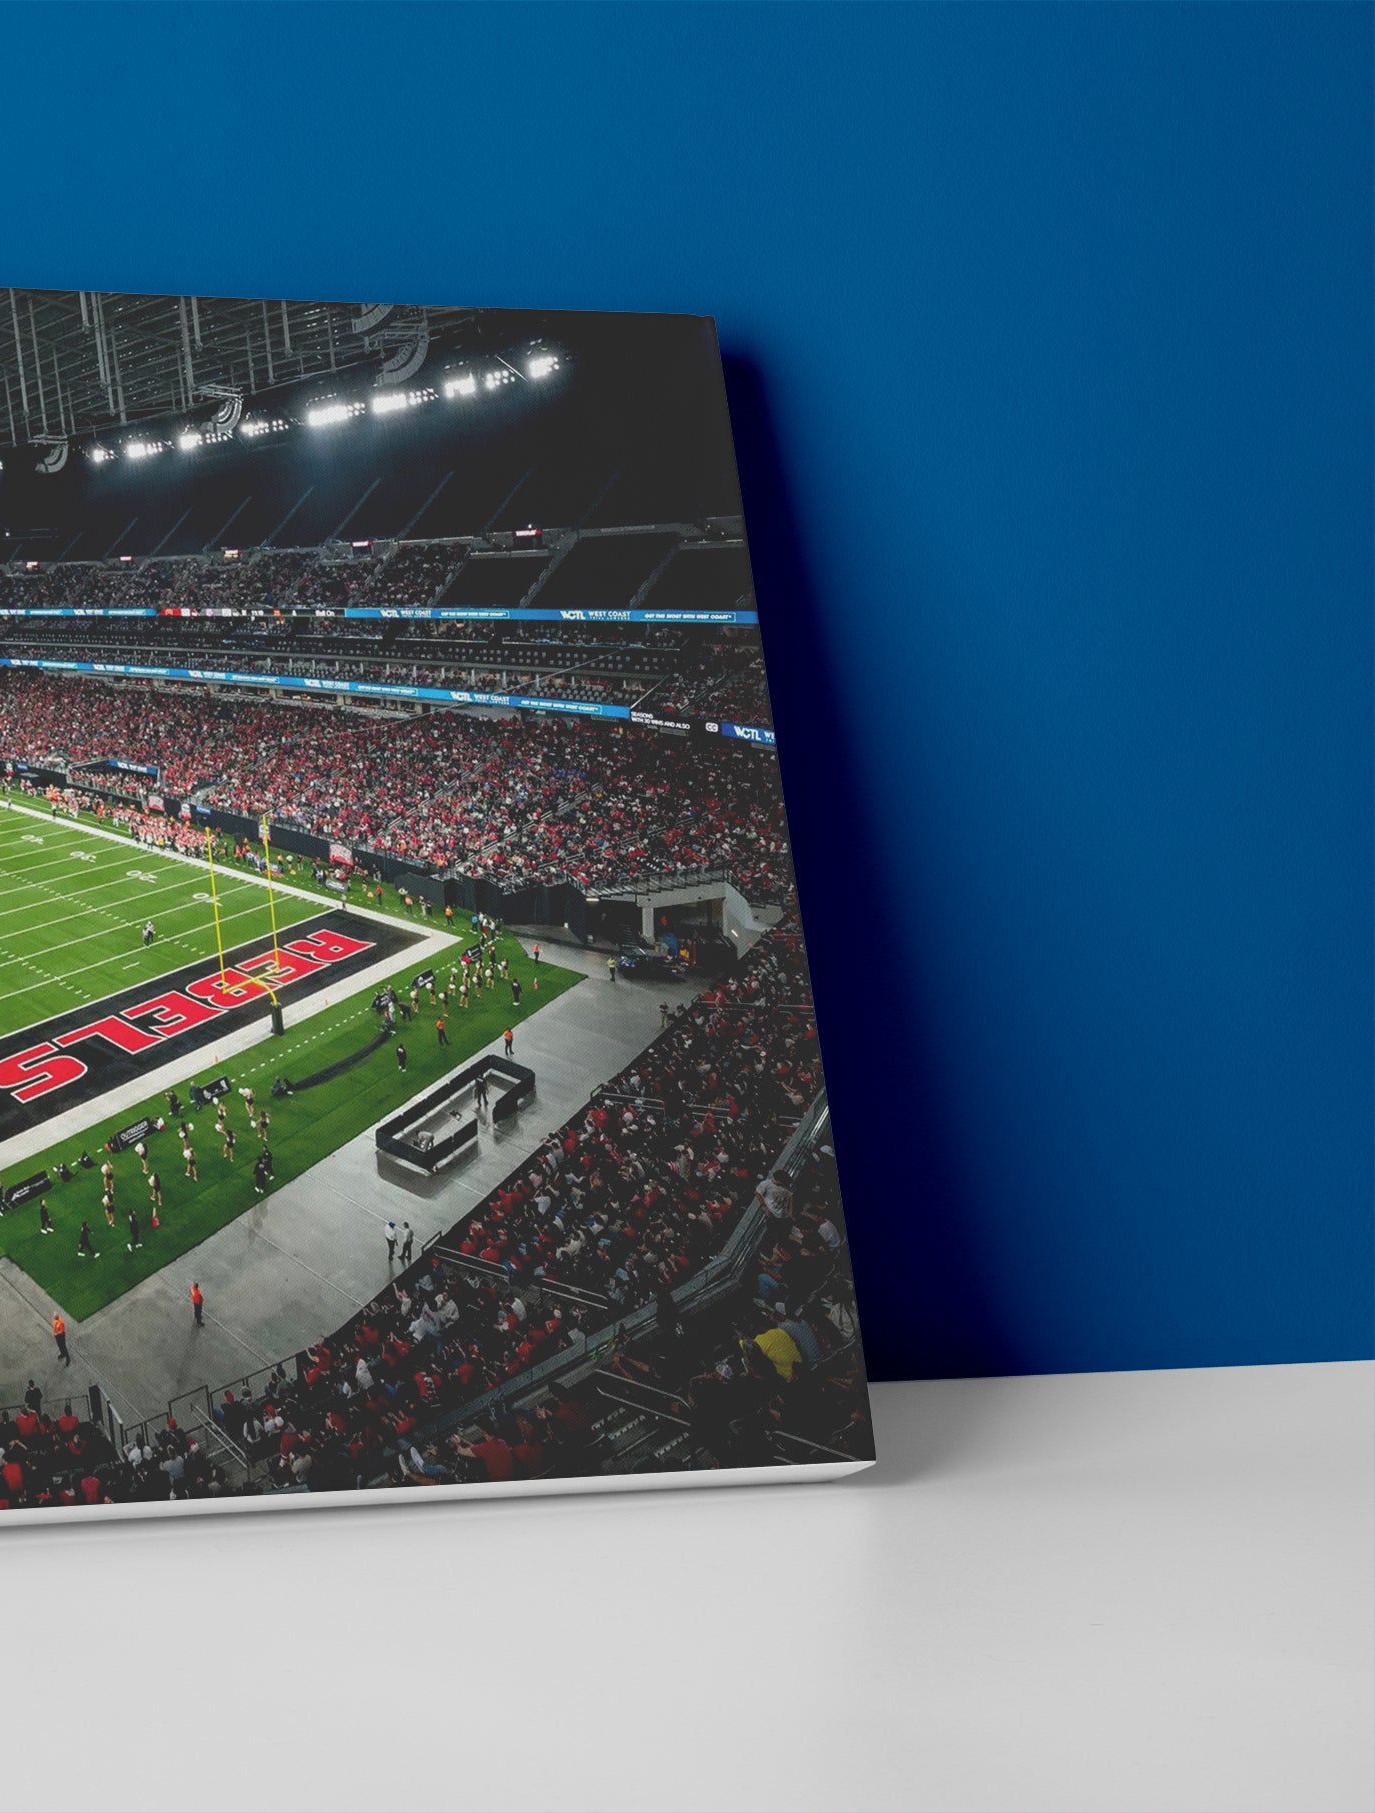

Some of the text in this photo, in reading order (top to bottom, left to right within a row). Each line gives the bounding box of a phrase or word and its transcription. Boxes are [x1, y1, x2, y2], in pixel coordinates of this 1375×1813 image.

[560, 610, 586, 620] WCTL
[631, 711, 653, 719] SEASONS
[734, 725, 762, 741] WCTL
